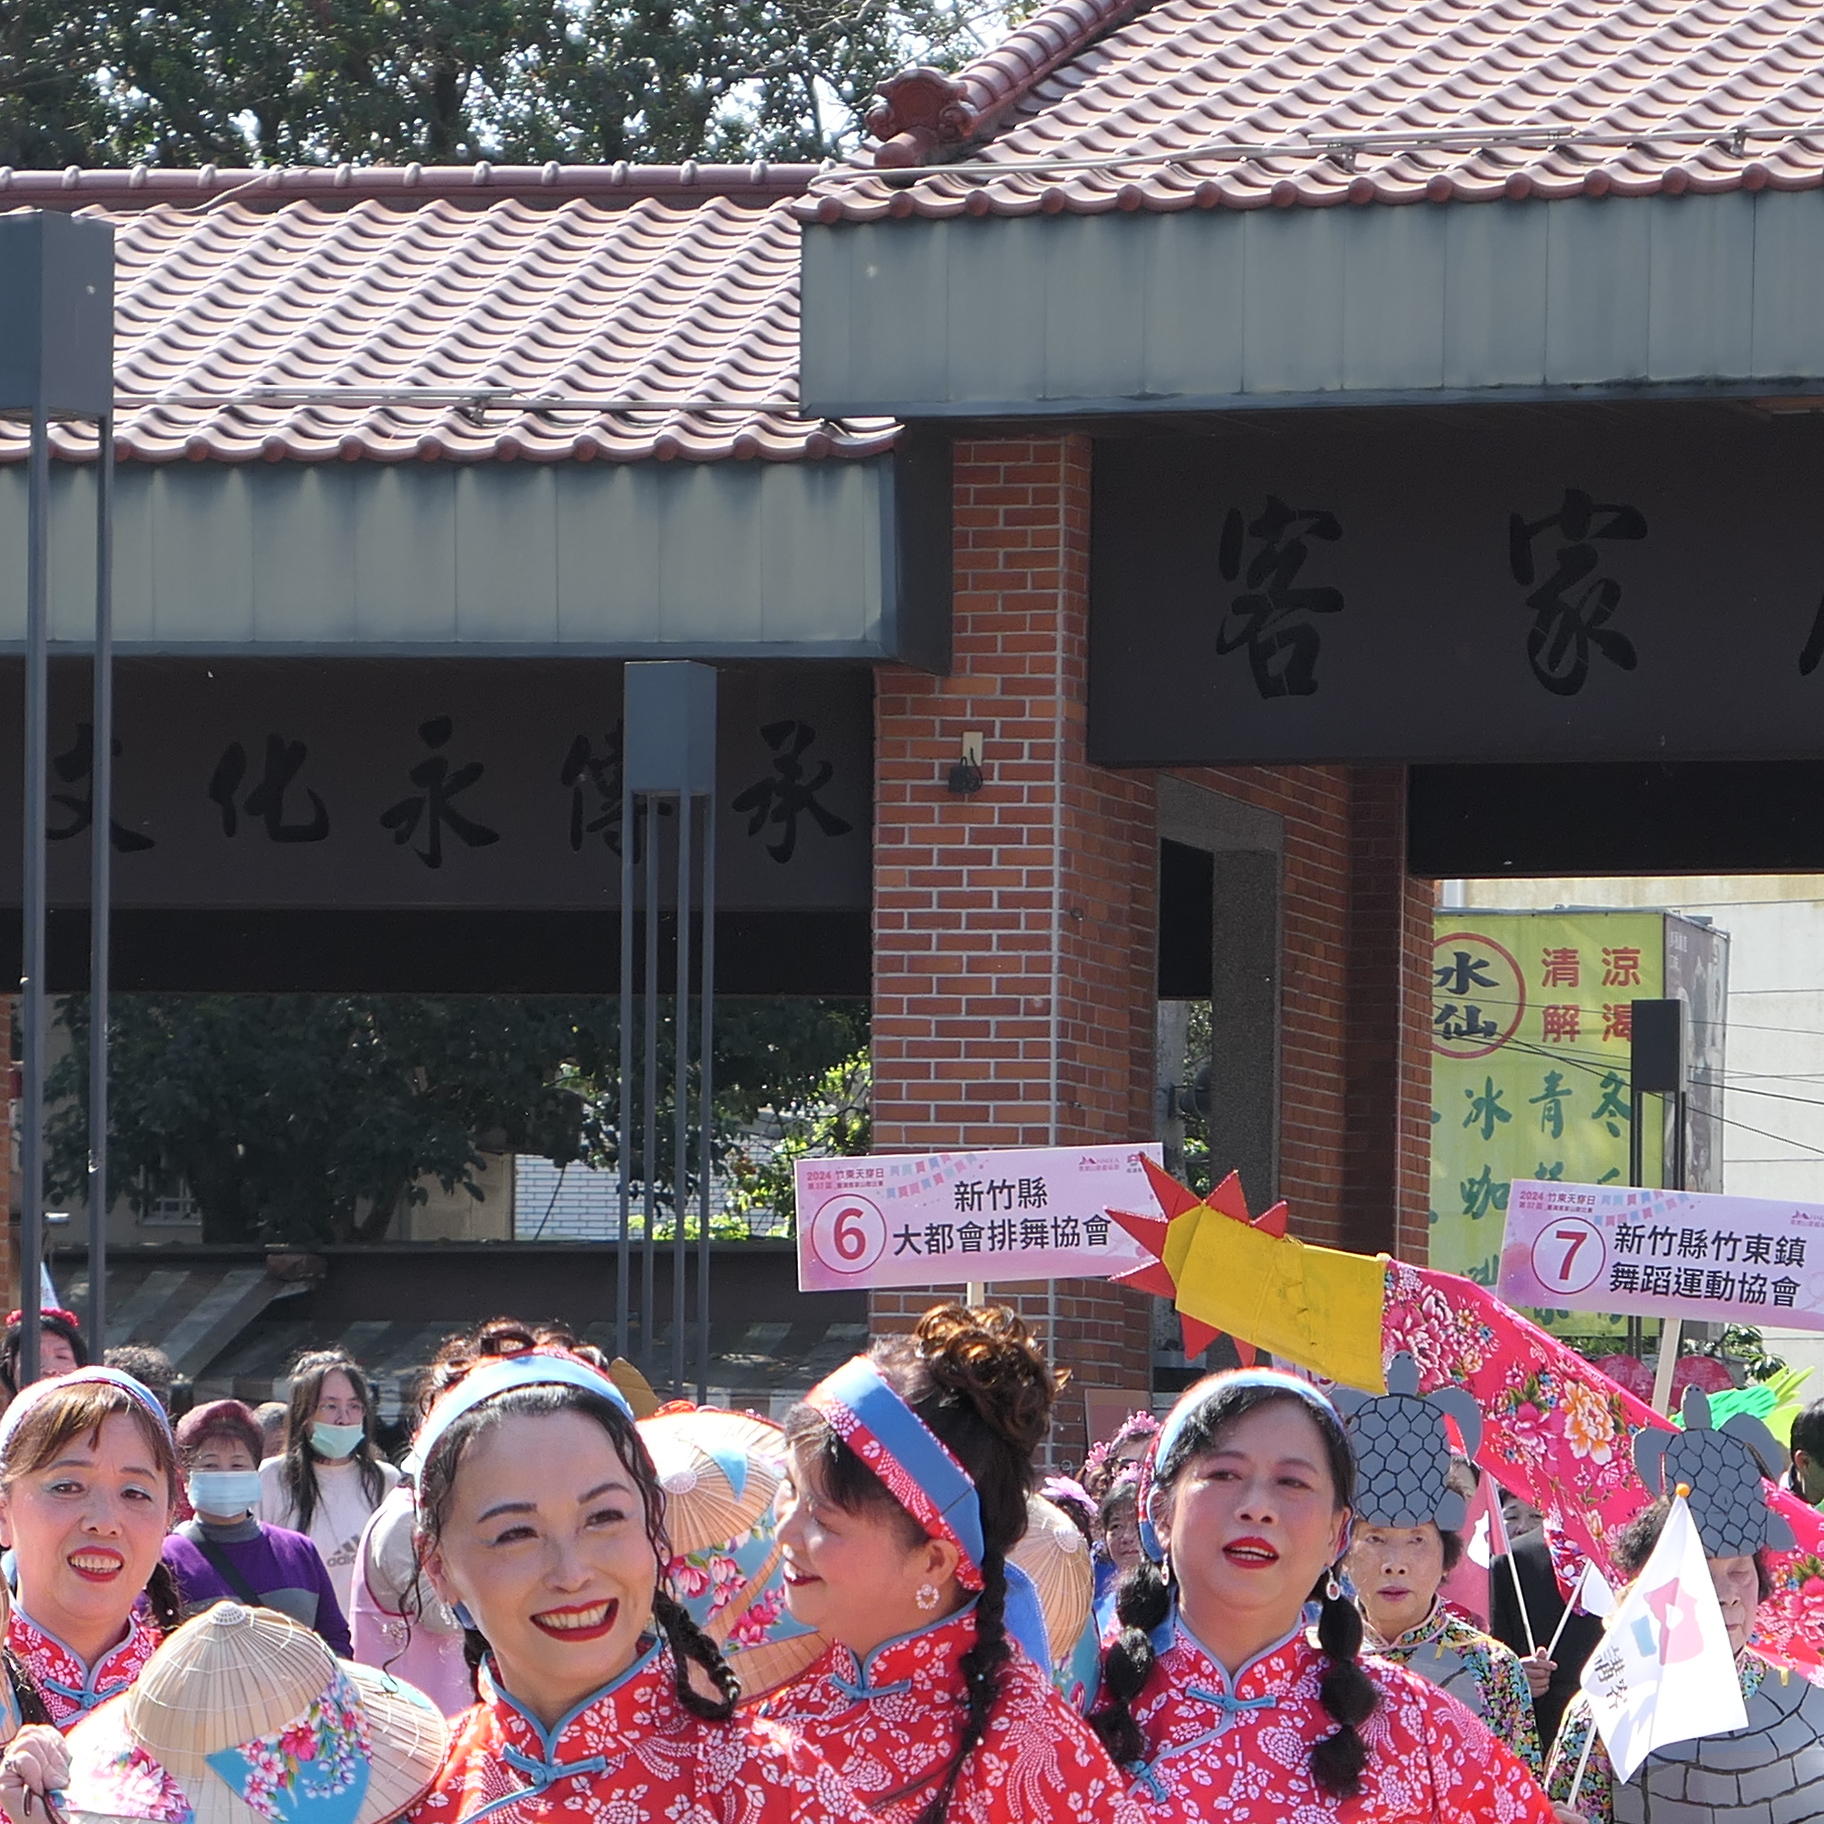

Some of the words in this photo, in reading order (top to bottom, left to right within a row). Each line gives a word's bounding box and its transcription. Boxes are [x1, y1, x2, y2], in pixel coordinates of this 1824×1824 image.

[1541, 946, 1641, 988] 清涼
[1433, 951, 1500, 1041] 水仙
[953, 1175, 1048, 1213] 新竹縣
[833, 1207, 867, 1261] 6
[892, 1213, 1112, 1257] 大都會排舞協會
[1555, 1230, 1588, 1281] 7
[1614, 1222, 1807, 1269] 新竹縣竹東鎮
[1609, 1261, 1802, 1308] 舞蹈運動協會
